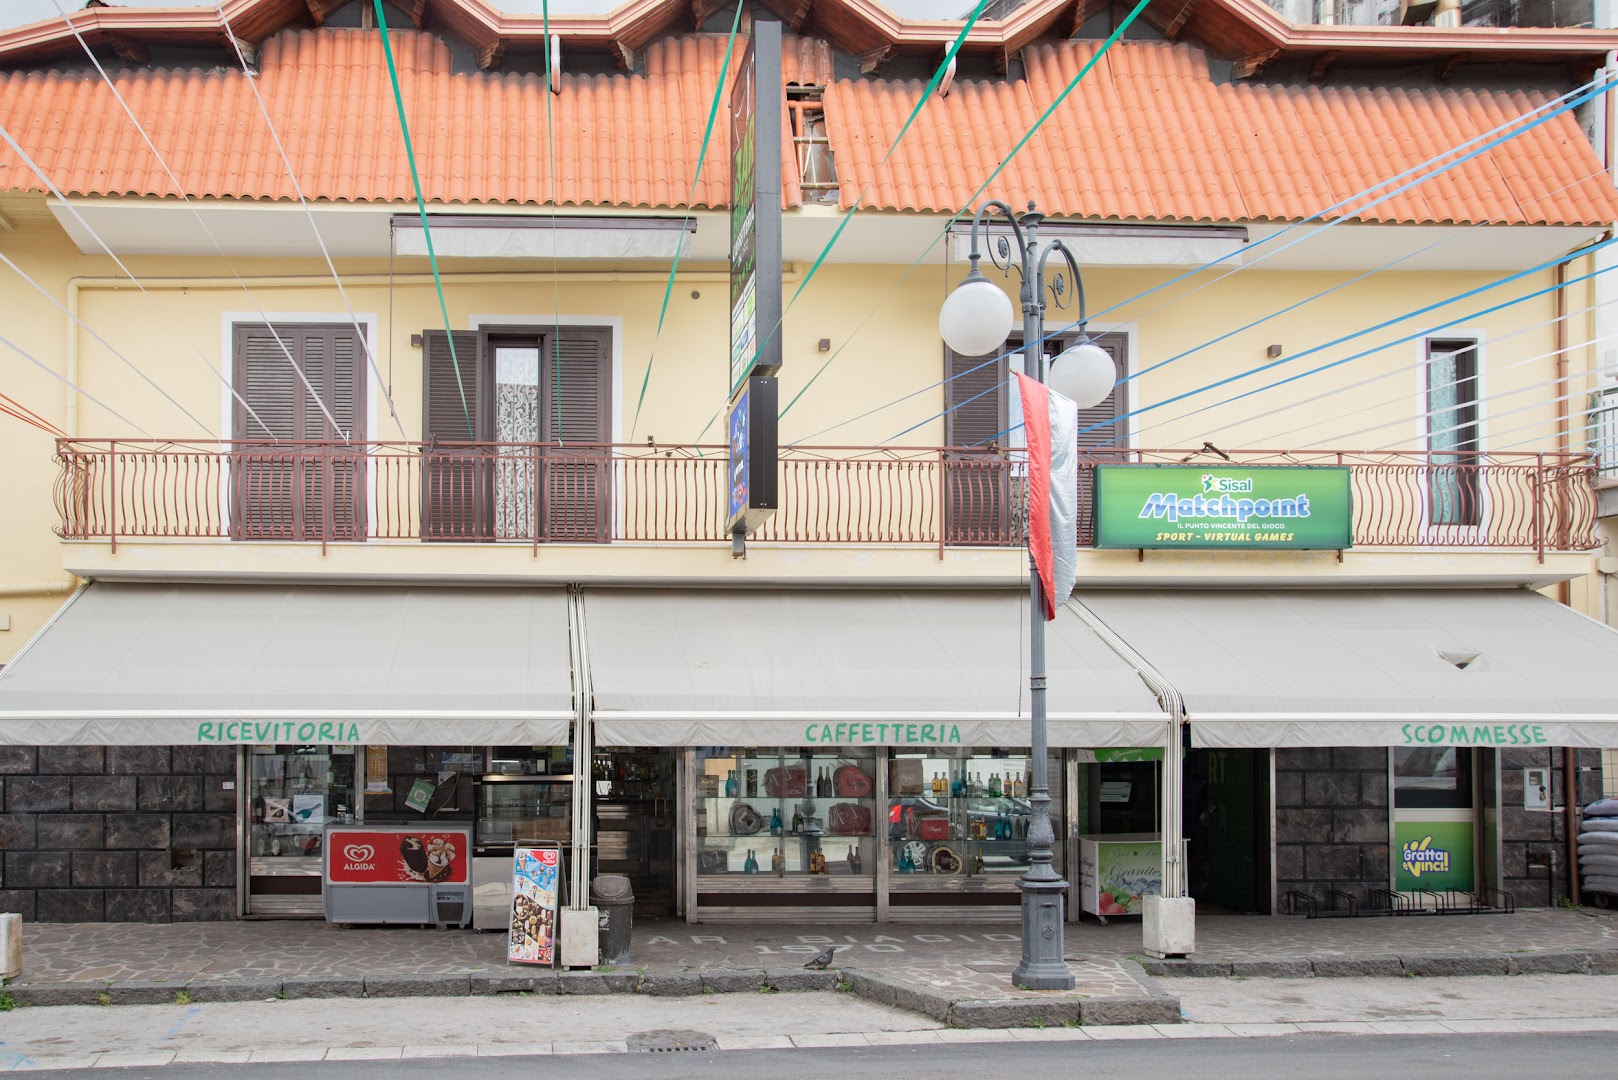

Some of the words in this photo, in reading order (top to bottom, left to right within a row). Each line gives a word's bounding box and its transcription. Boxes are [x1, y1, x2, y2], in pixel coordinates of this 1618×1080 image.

[1218, 478, 1252, 492] Sisal
[1138, 493, 1311, 522] Matchpoint
[1156, 532, 1194, 542] SPORT
[1204, 532, 1251, 542] VIRTUAL
[1254, 532, 1294, 542] GAMES
[197, 722, 360, 742] RICEVITORIA
[805, 723, 961, 743] CAFFETTERIA
[1401, 723, 1548, 744] SCOMMESSE
[1403, 849, 1444, 861] Gratta
[343, 863, 375, 871] ALGIDA
[796, 933, 1021, 944] BIAGIO
[754, 944, 906, 954] 1970
